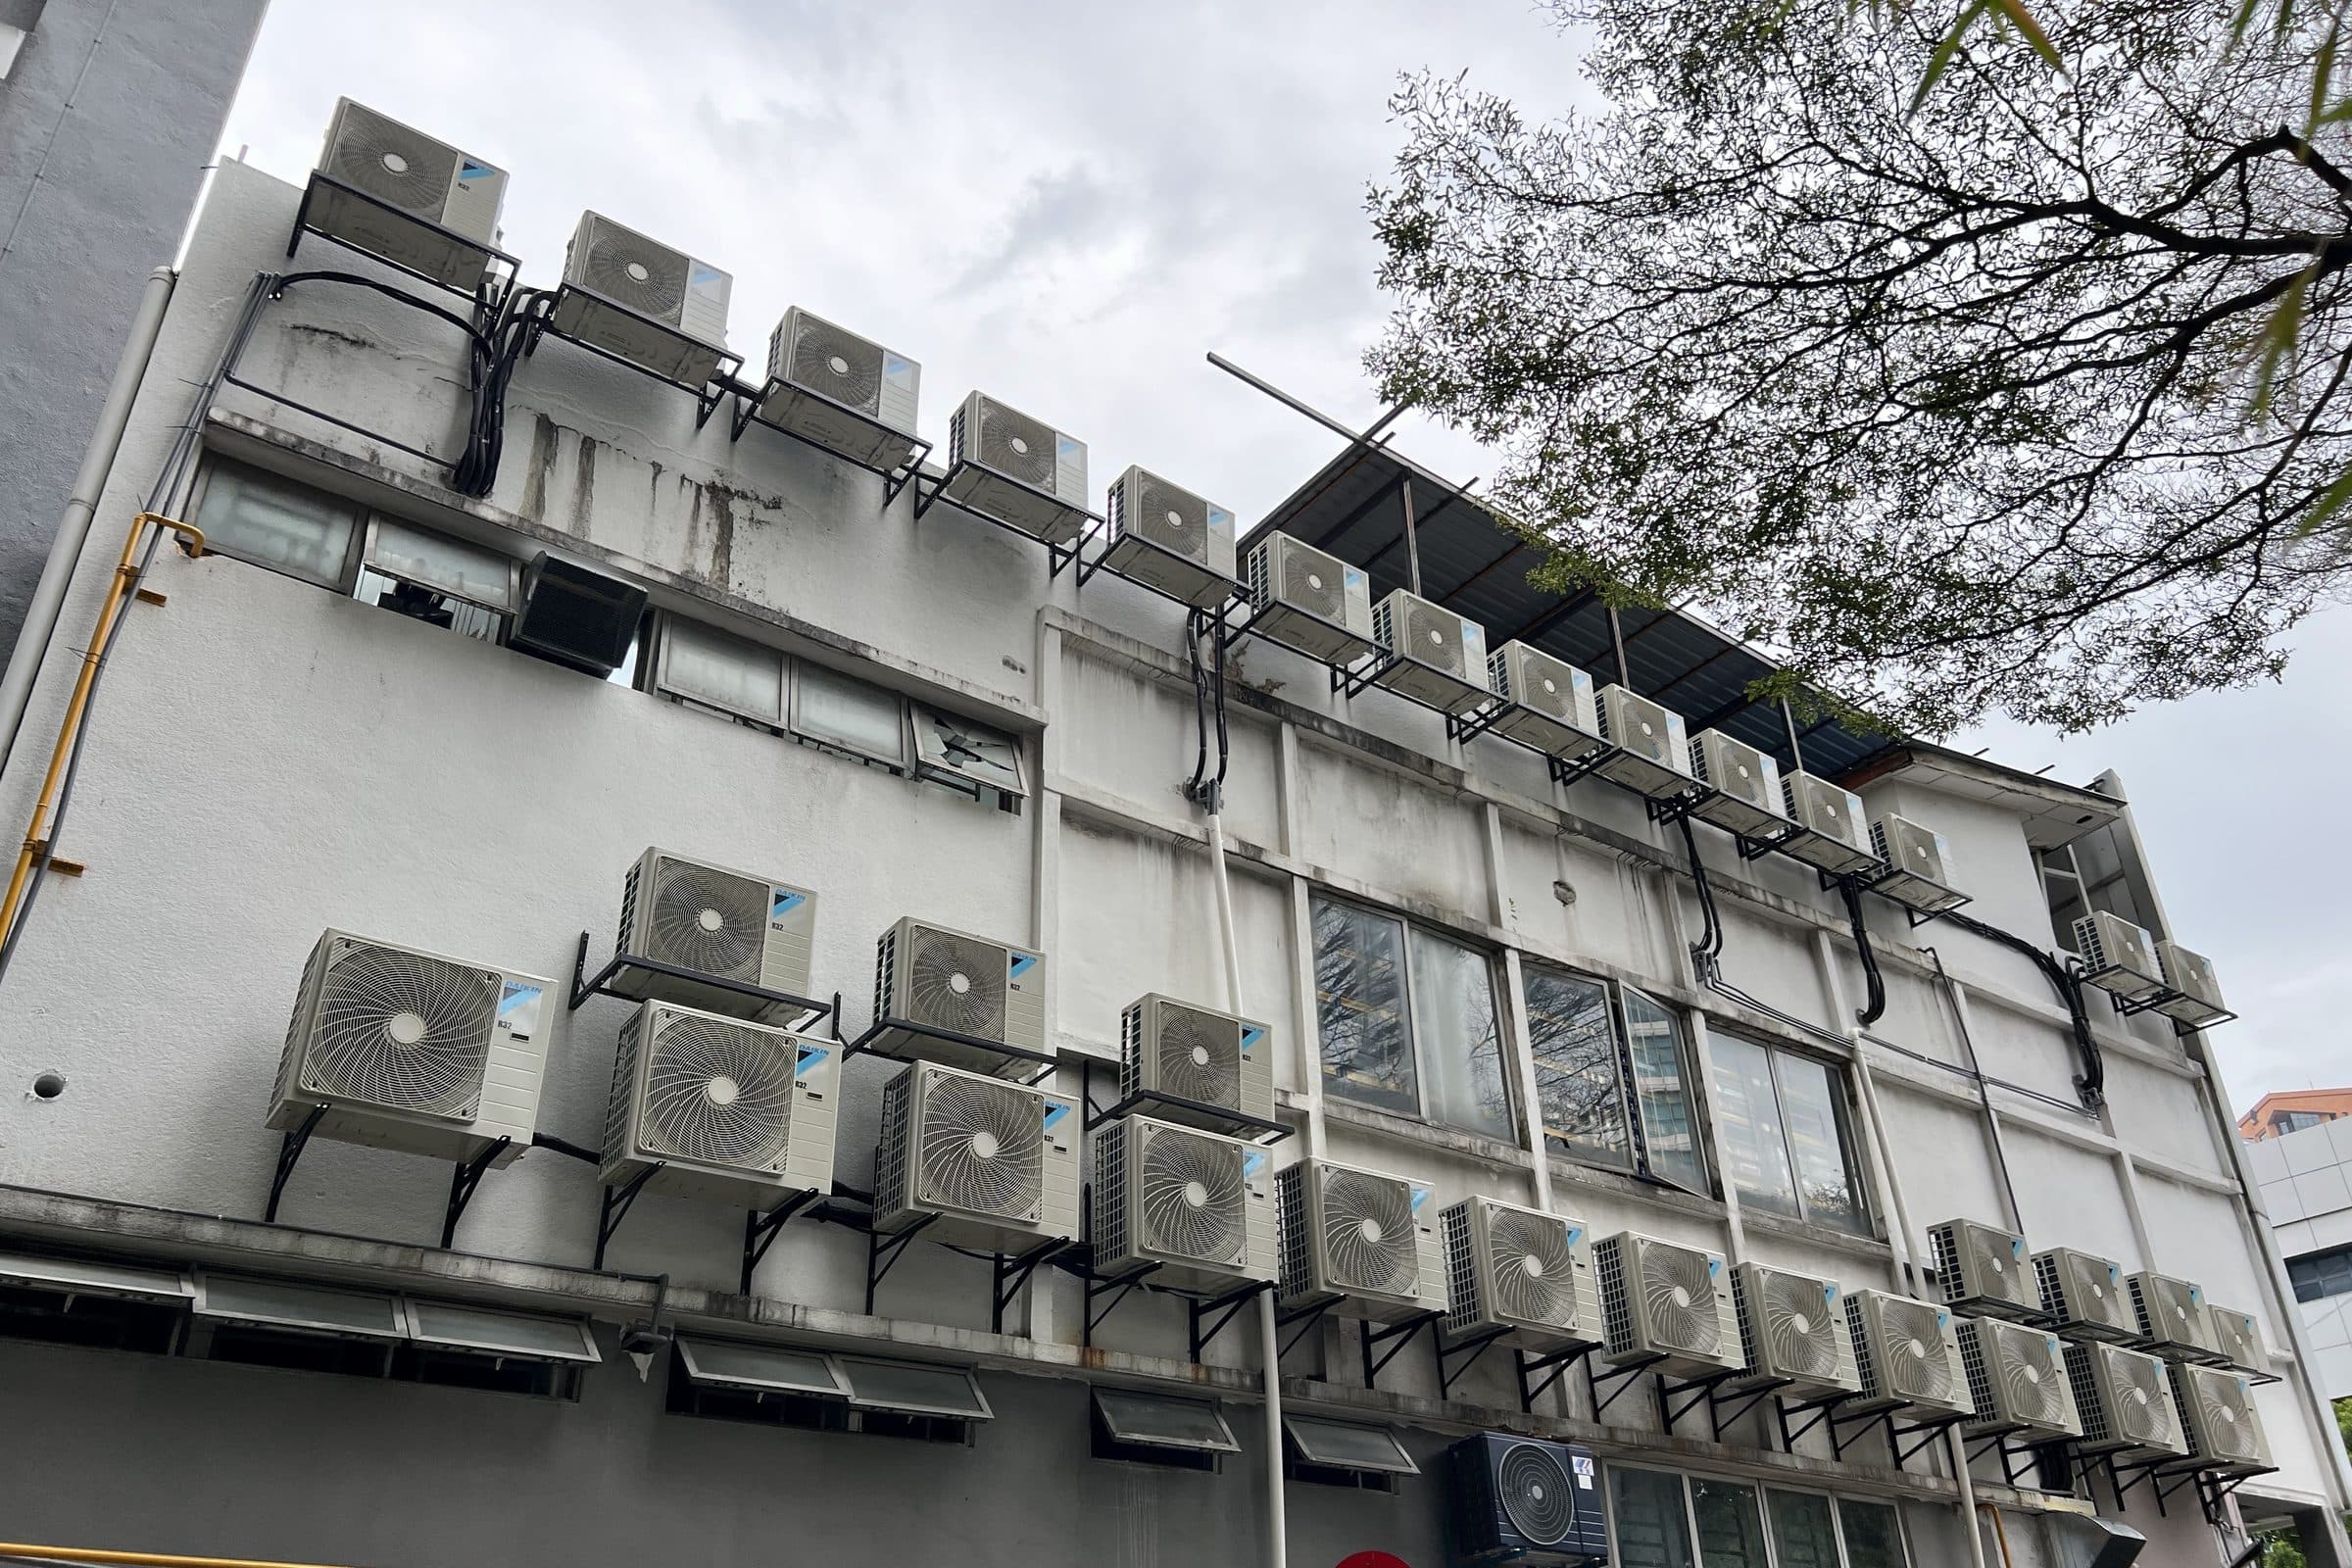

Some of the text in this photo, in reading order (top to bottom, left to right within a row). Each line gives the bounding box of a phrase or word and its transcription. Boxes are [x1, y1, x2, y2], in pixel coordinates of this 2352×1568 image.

[775, 888, 806, 901] DAIKIN
[771, 922, 784, 931] R32
[505, 981, 543, 993] DAIKIN
[498, 1020, 513, 1030] R32
[799, 1044, 830, 1055] DAIKIN
[795, 1081, 807, 1090] R32
